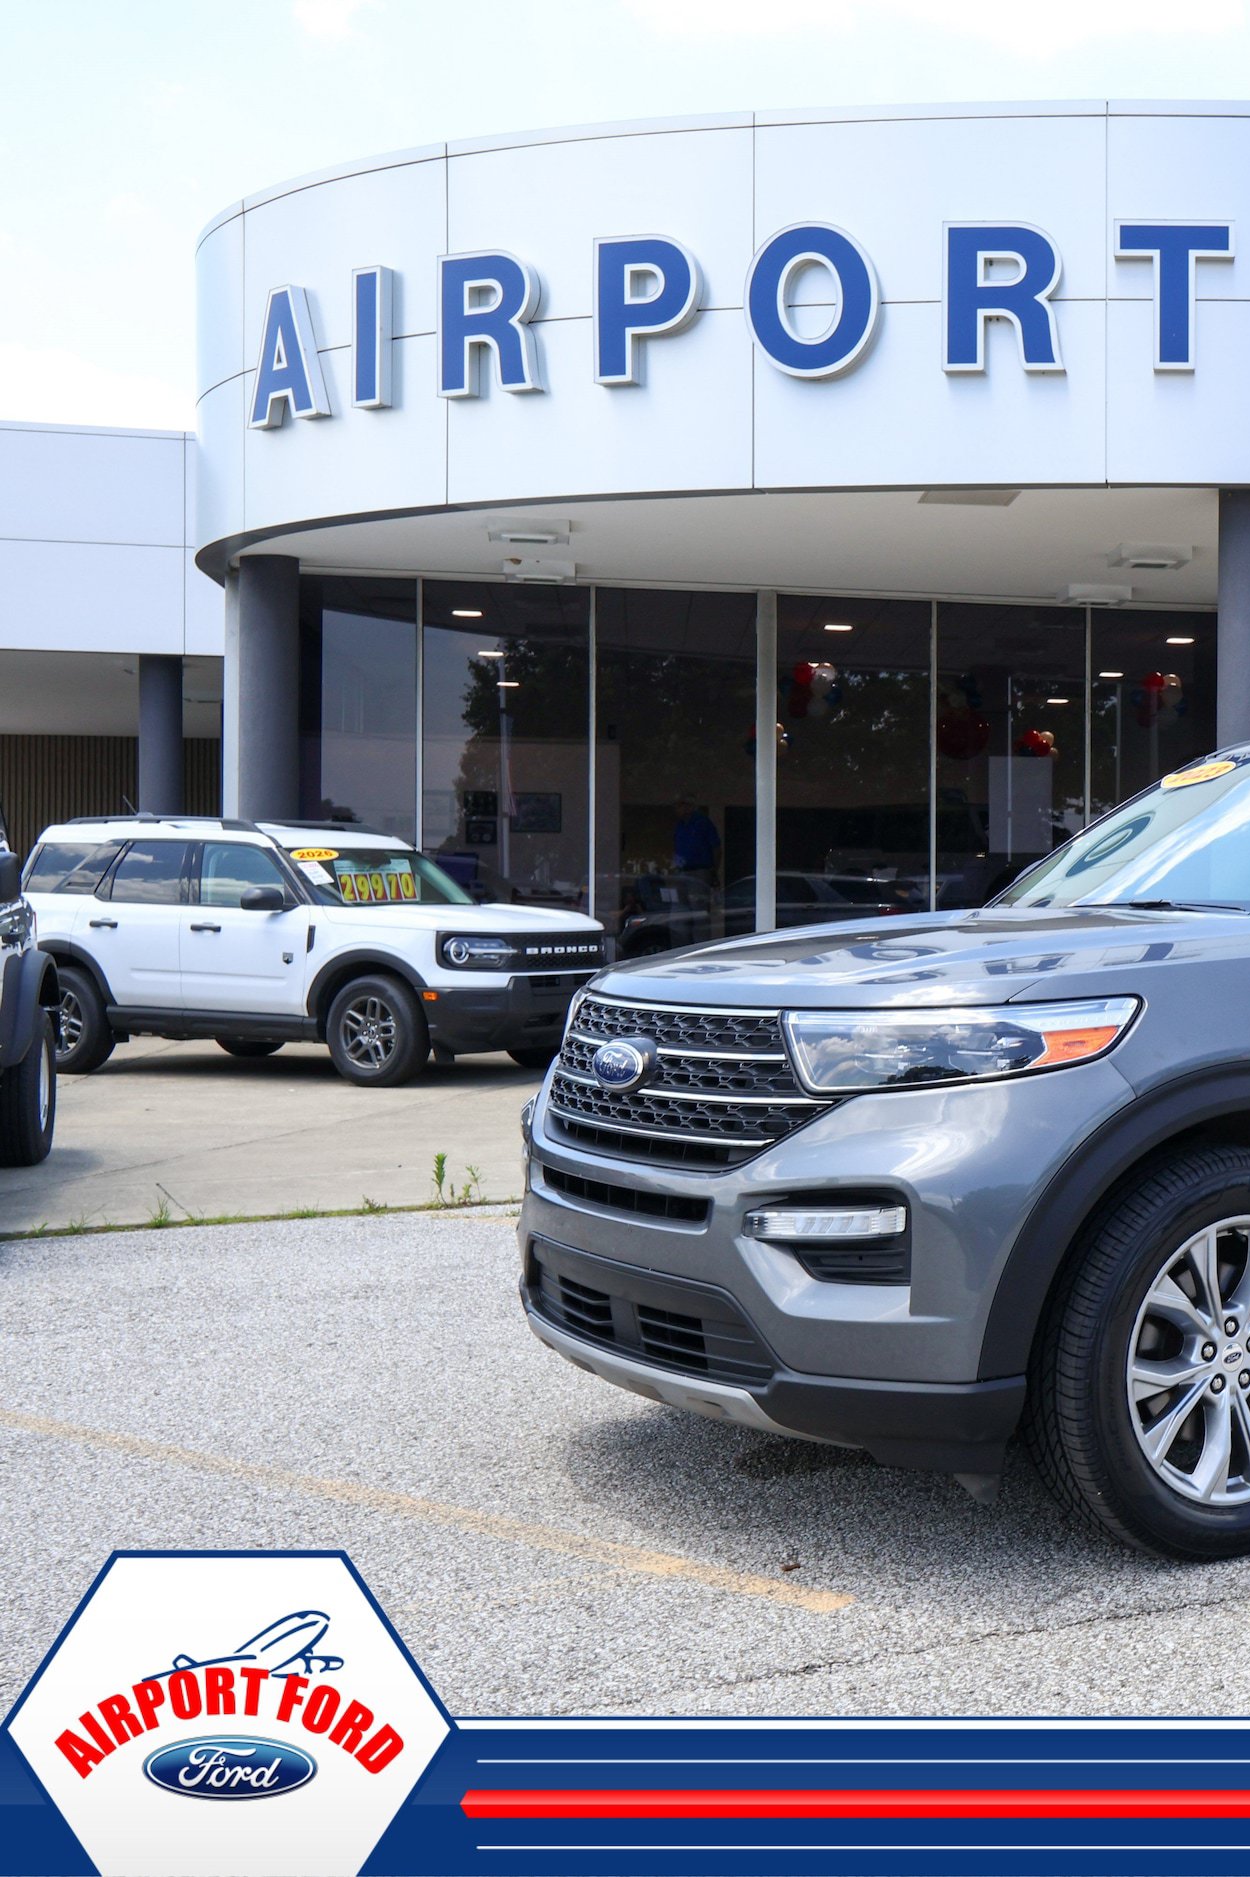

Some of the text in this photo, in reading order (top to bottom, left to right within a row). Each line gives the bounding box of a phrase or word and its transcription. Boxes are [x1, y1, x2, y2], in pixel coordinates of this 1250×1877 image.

[246, 218, 1235, 431] AIRPORT
[297, 850, 334, 859] 2026
[526, 944, 598, 955] BRONCO
